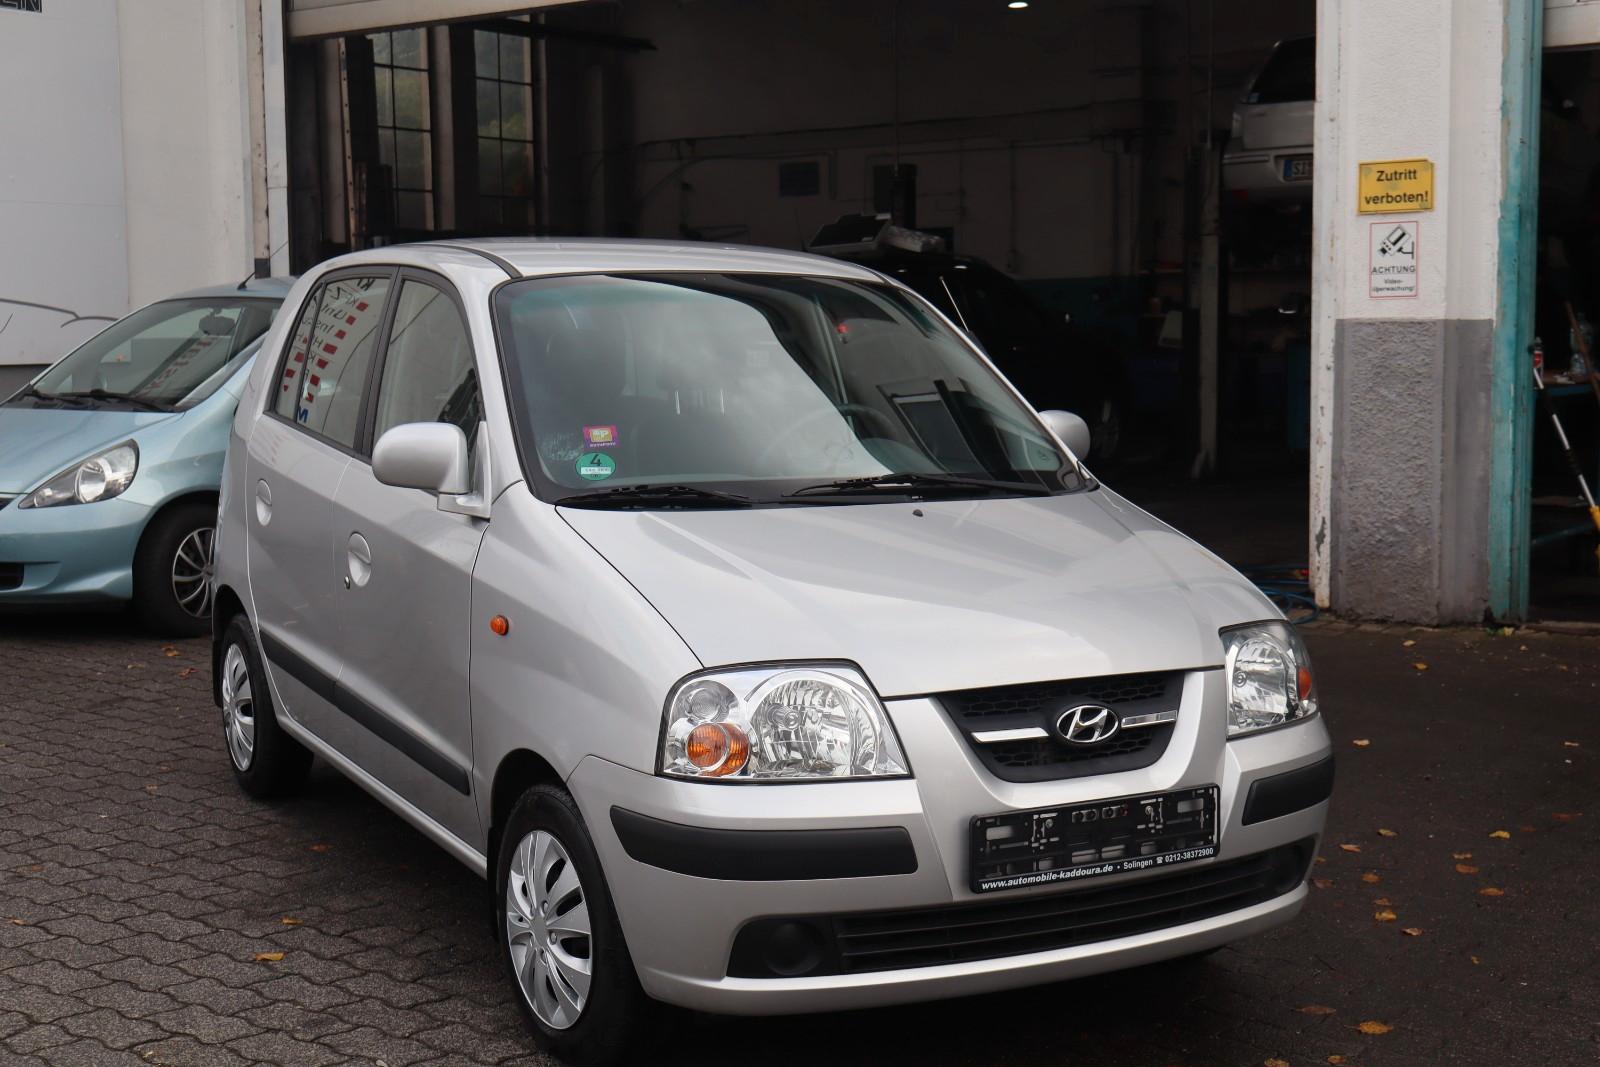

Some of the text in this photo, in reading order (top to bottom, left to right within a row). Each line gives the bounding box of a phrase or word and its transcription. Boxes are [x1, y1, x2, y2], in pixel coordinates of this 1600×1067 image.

[1375, 169, 1417, 182] Zutritt
[1364, 190, 1428, 205] verboten!
[1372, 265, 1416, 274] ACHTUNG
[590, 454, 602, 466] 4
[981, 848, 1214, 890] www.automobile-kaddoura.de Solingen 0212-38372900
